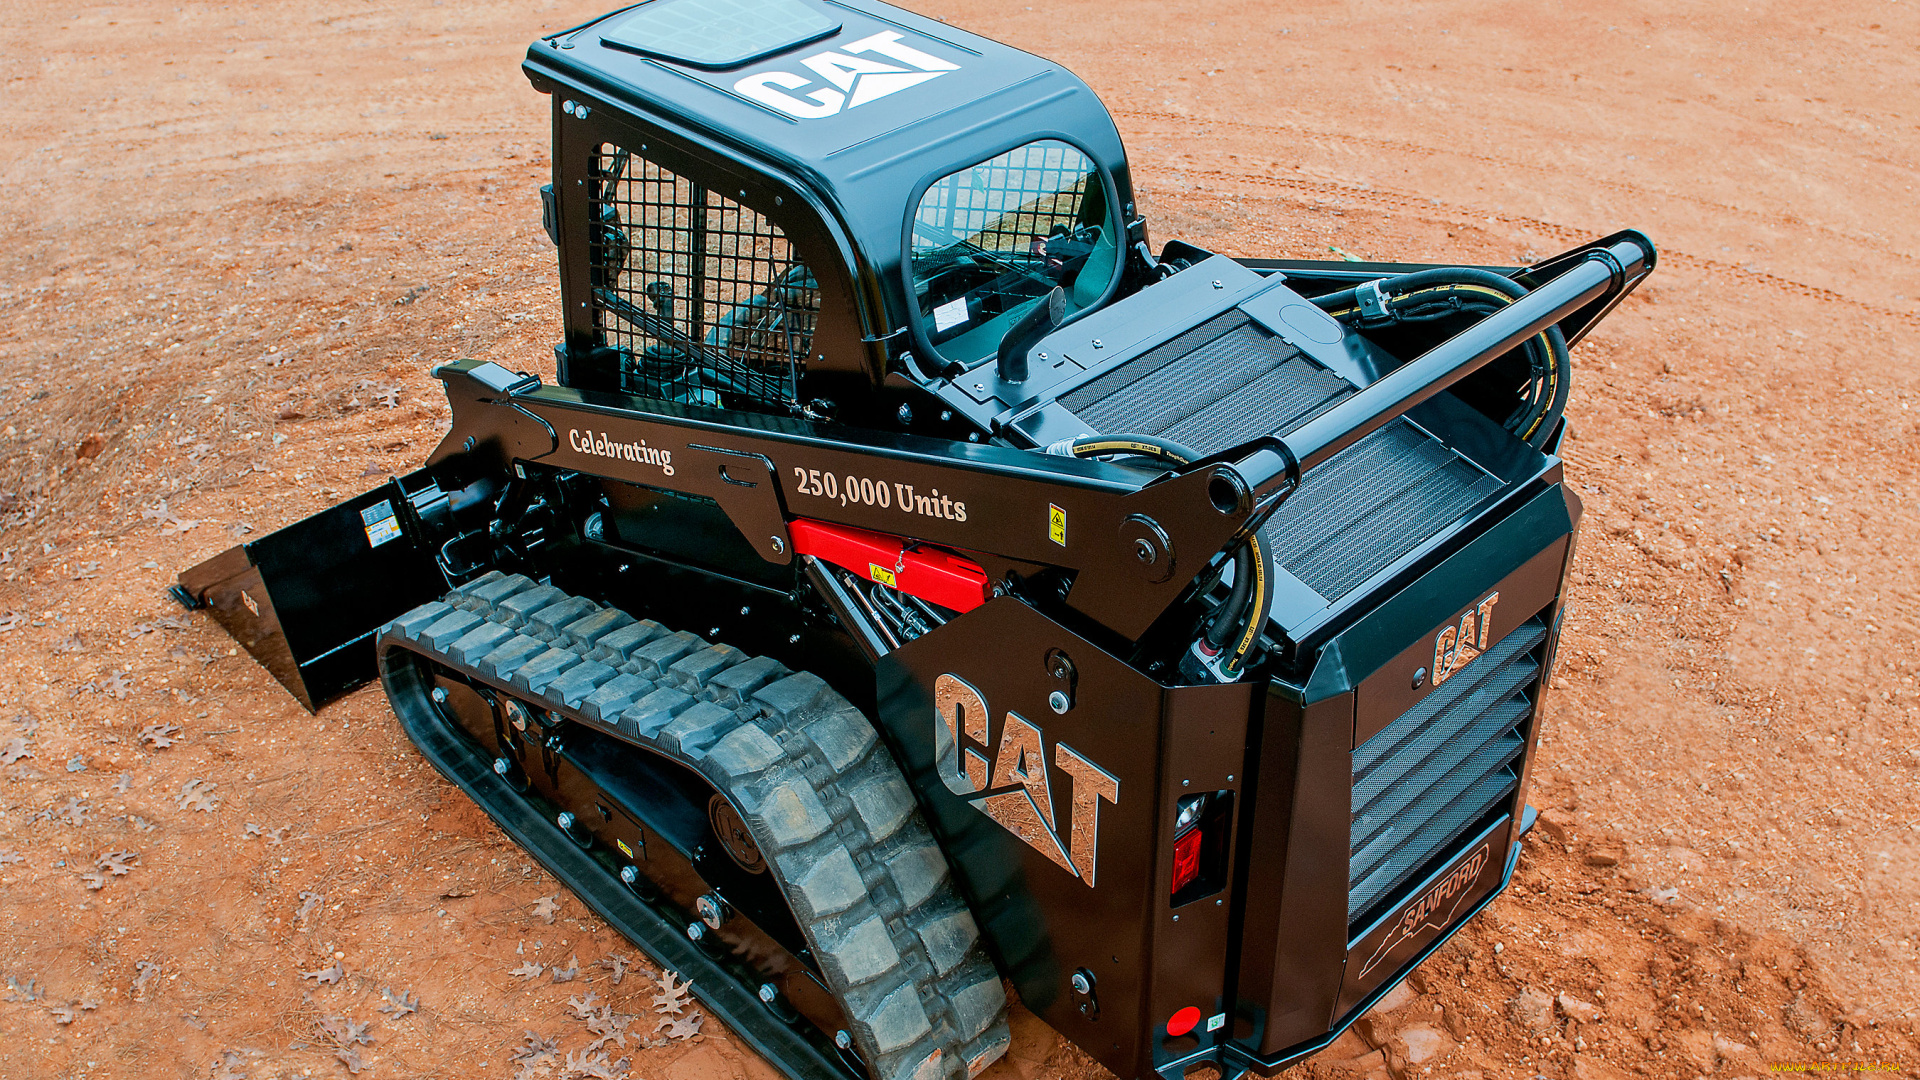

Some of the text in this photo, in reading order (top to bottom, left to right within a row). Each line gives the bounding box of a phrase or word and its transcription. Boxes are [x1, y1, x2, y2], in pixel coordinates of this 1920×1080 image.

[734, 30, 962, 119] CAT
[569, 428, 675, 476] Celebrating
[794, 467, 967, 522] 250,000 Units
[1431, 591, 1499, 686] CAT
[935, 673, 1121, 888] CAT
[1402, 853, 1482, 936] SANFORD
